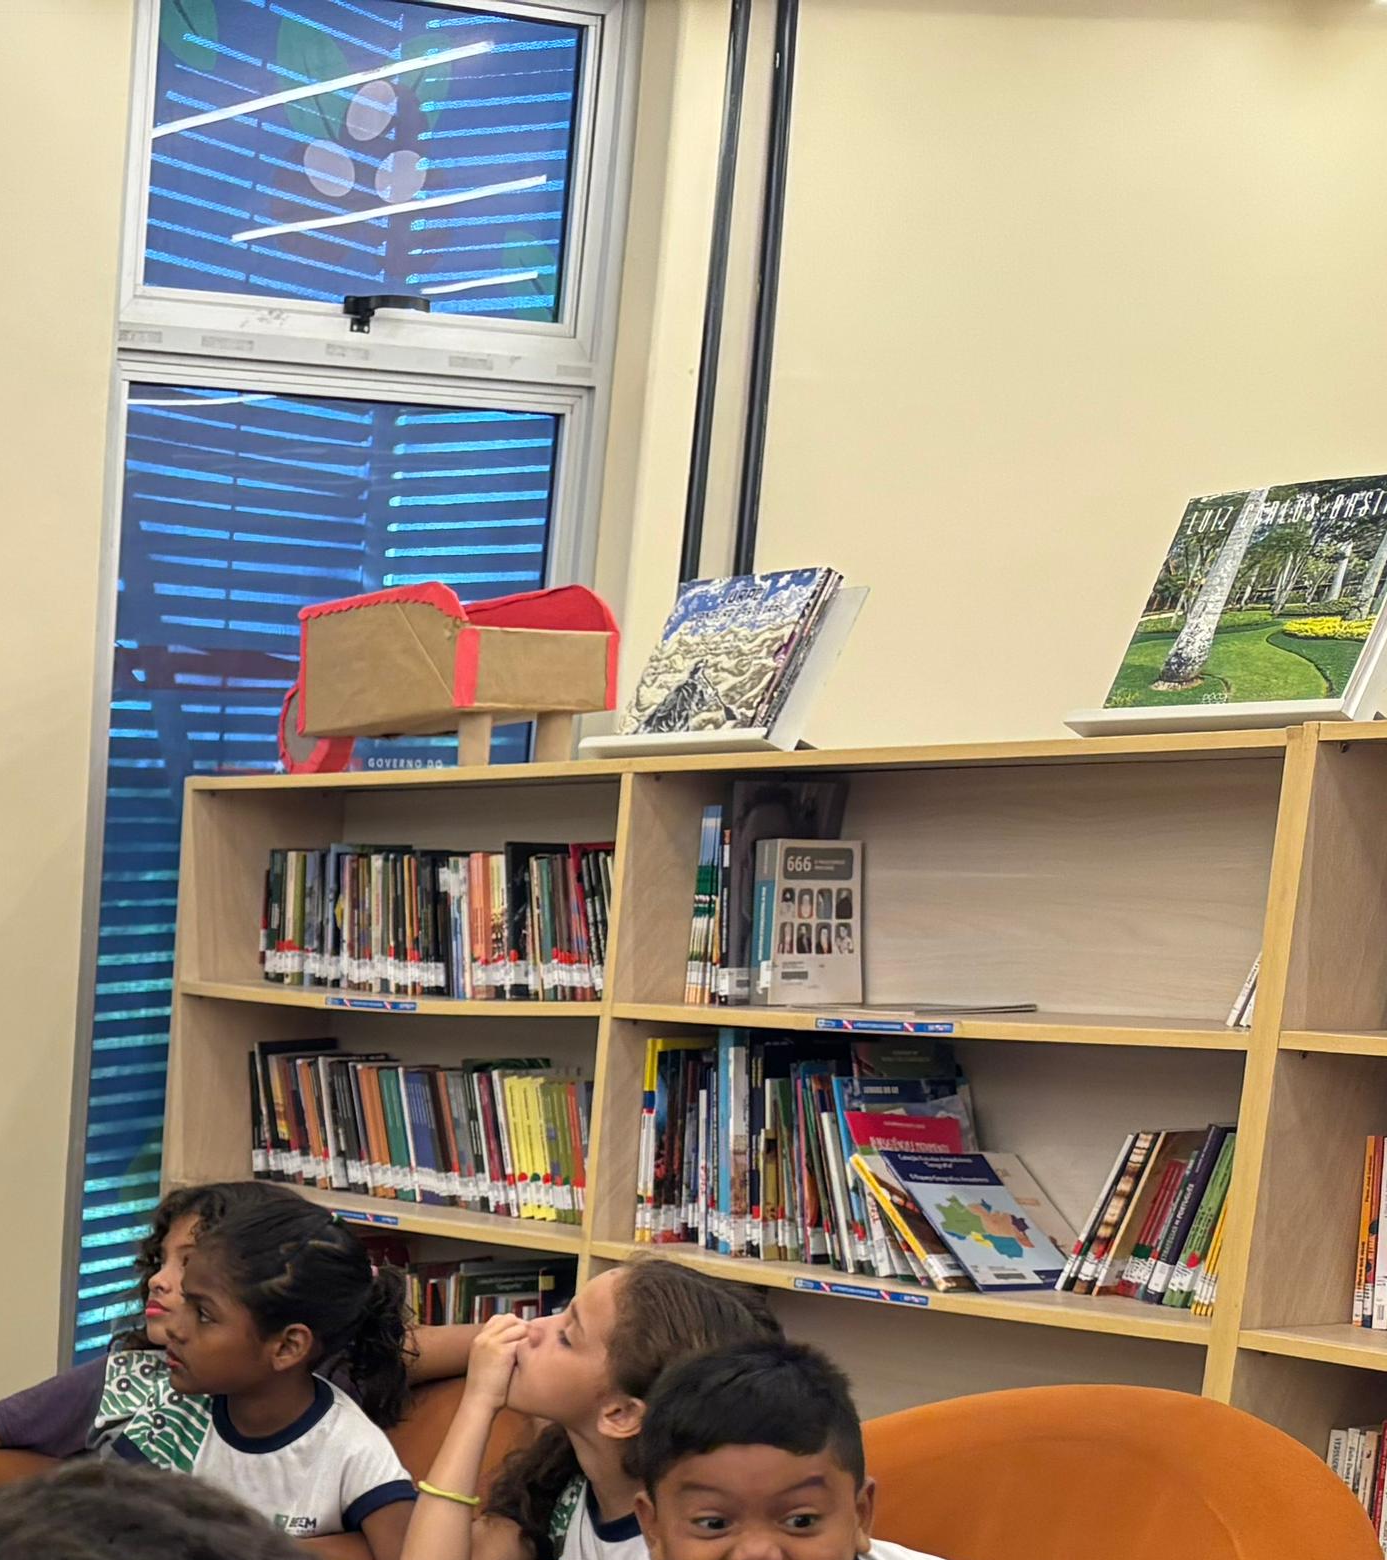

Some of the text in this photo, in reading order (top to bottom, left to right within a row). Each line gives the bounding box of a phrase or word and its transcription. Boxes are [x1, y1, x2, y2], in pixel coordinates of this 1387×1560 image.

[1187, 506, 1234, 534] LUIZ
[368, 758, 422, 769] GOVERNO
[787, 855, 812, 872] 666
